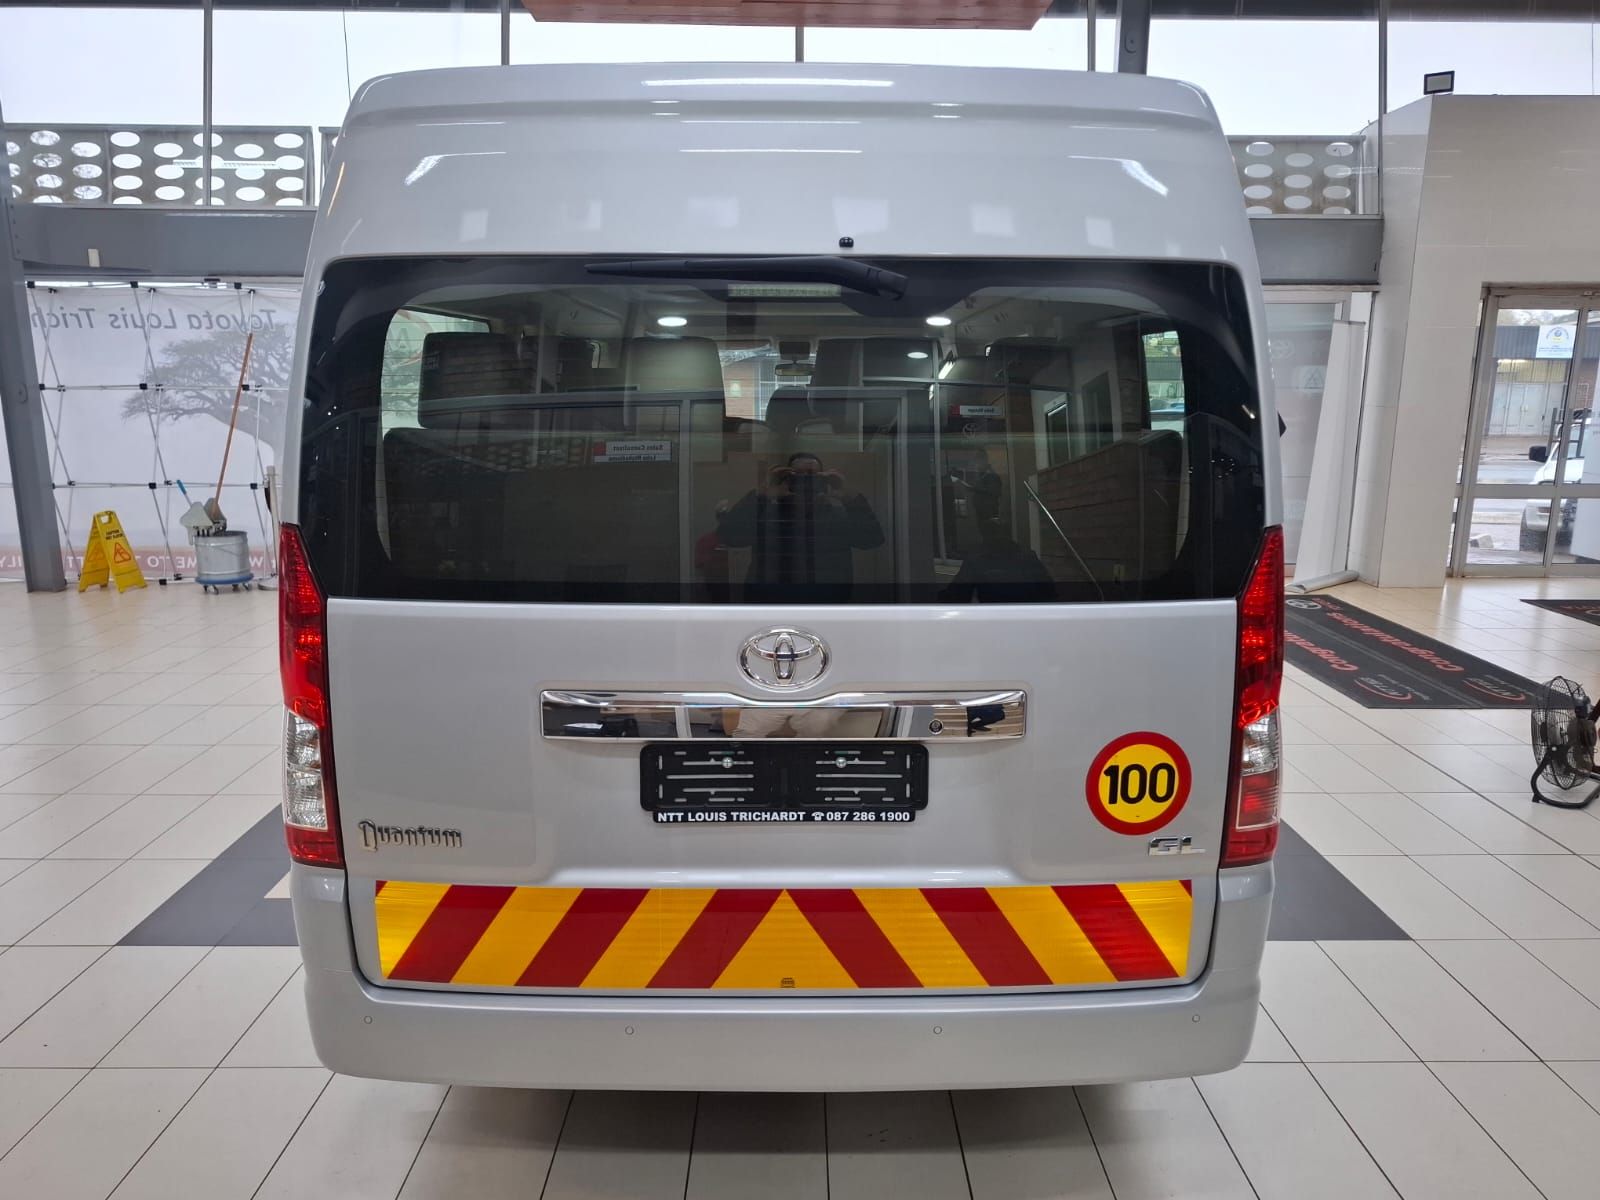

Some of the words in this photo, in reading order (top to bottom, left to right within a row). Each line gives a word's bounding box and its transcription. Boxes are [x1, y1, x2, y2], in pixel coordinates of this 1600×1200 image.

[1103, 762, 1176, 805] 100
[657, 812, 684, 823] NTT
[687, 812, 727, 822] LOUIS
[731, 811, 806, 822] TRICHARDT
[826, 811, 849, 822] 087
[852, 811, 876, 822] 286
[879, 811, 910, 822] 1900
[358, 818, 463, 852] Quantum
[1147, 836, 1206, 856] GL
